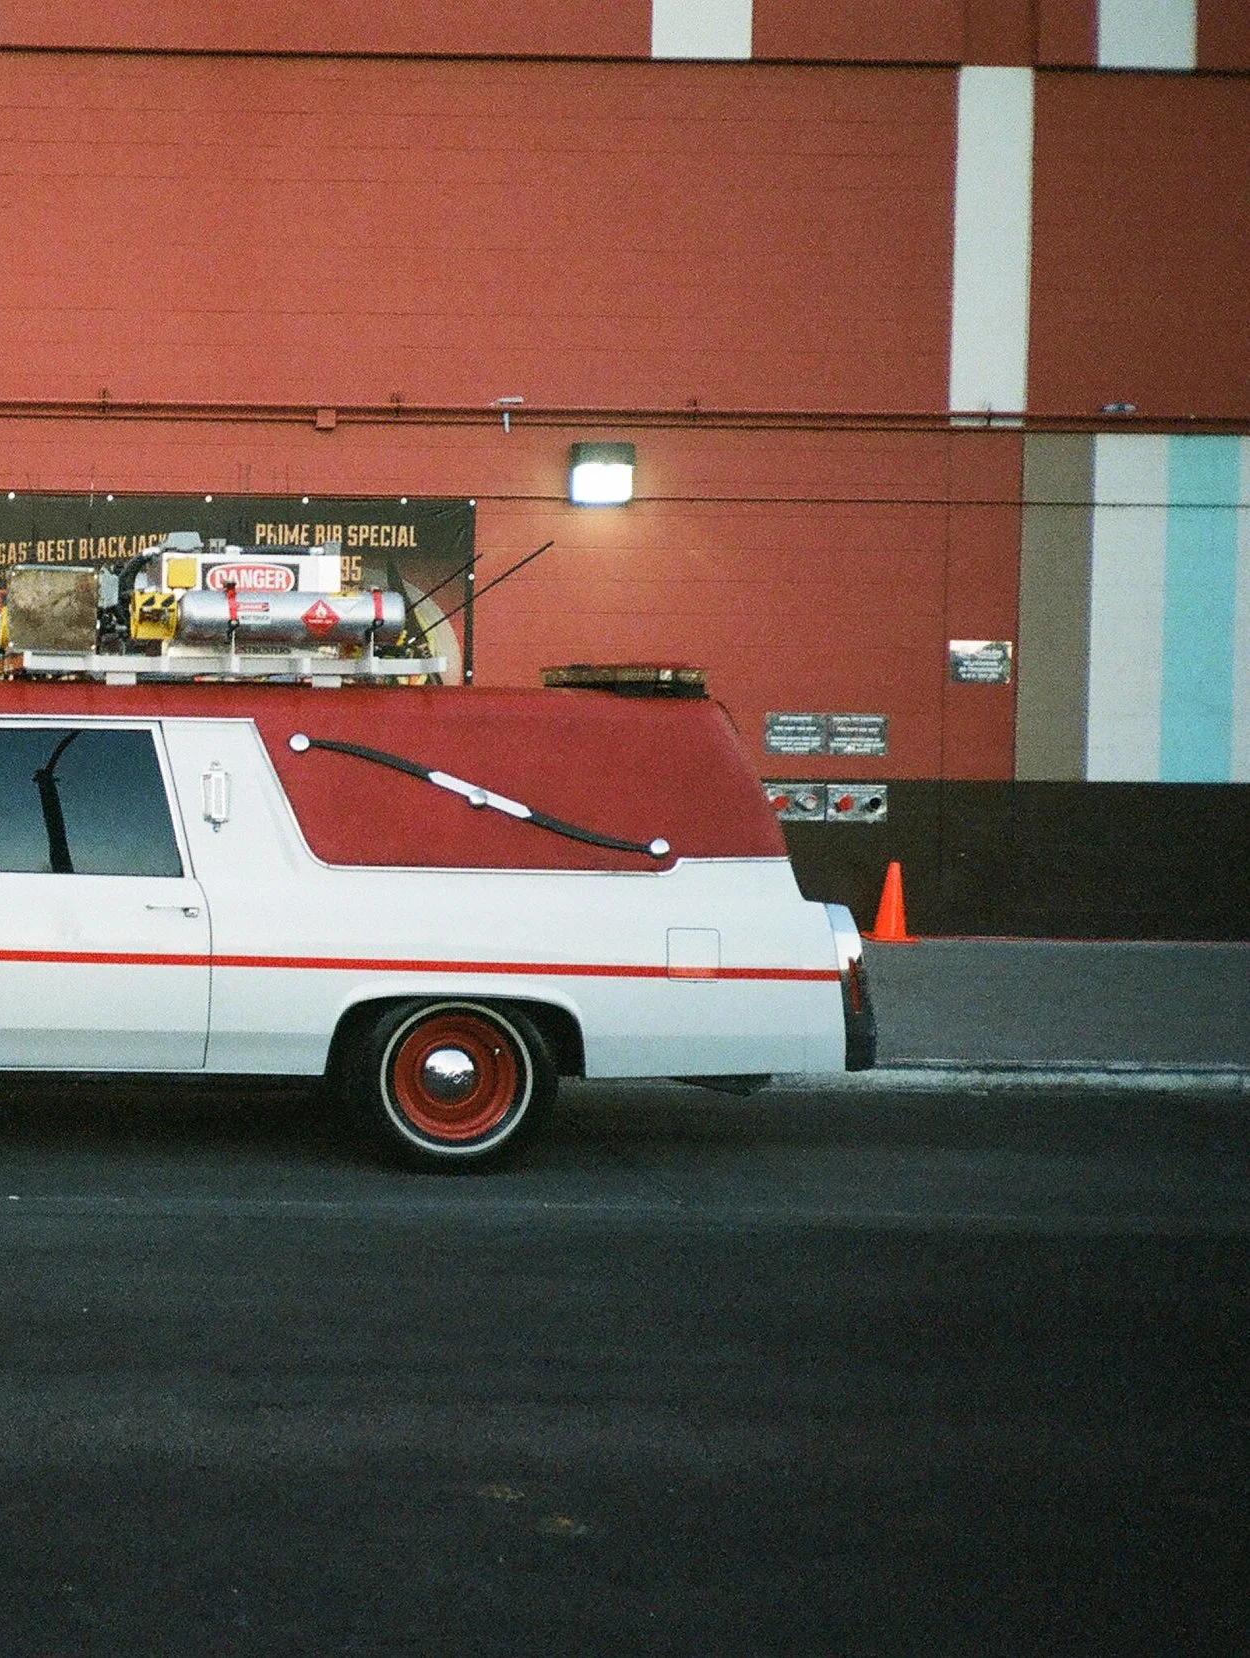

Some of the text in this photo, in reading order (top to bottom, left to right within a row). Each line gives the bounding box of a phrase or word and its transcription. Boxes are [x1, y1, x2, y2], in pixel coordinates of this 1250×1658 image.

[255, 523, 418, 548] PRIME RIB SPECIAL
[37, 538, 74, 563] BEST
[215, 569, 287, 589] DANGER
